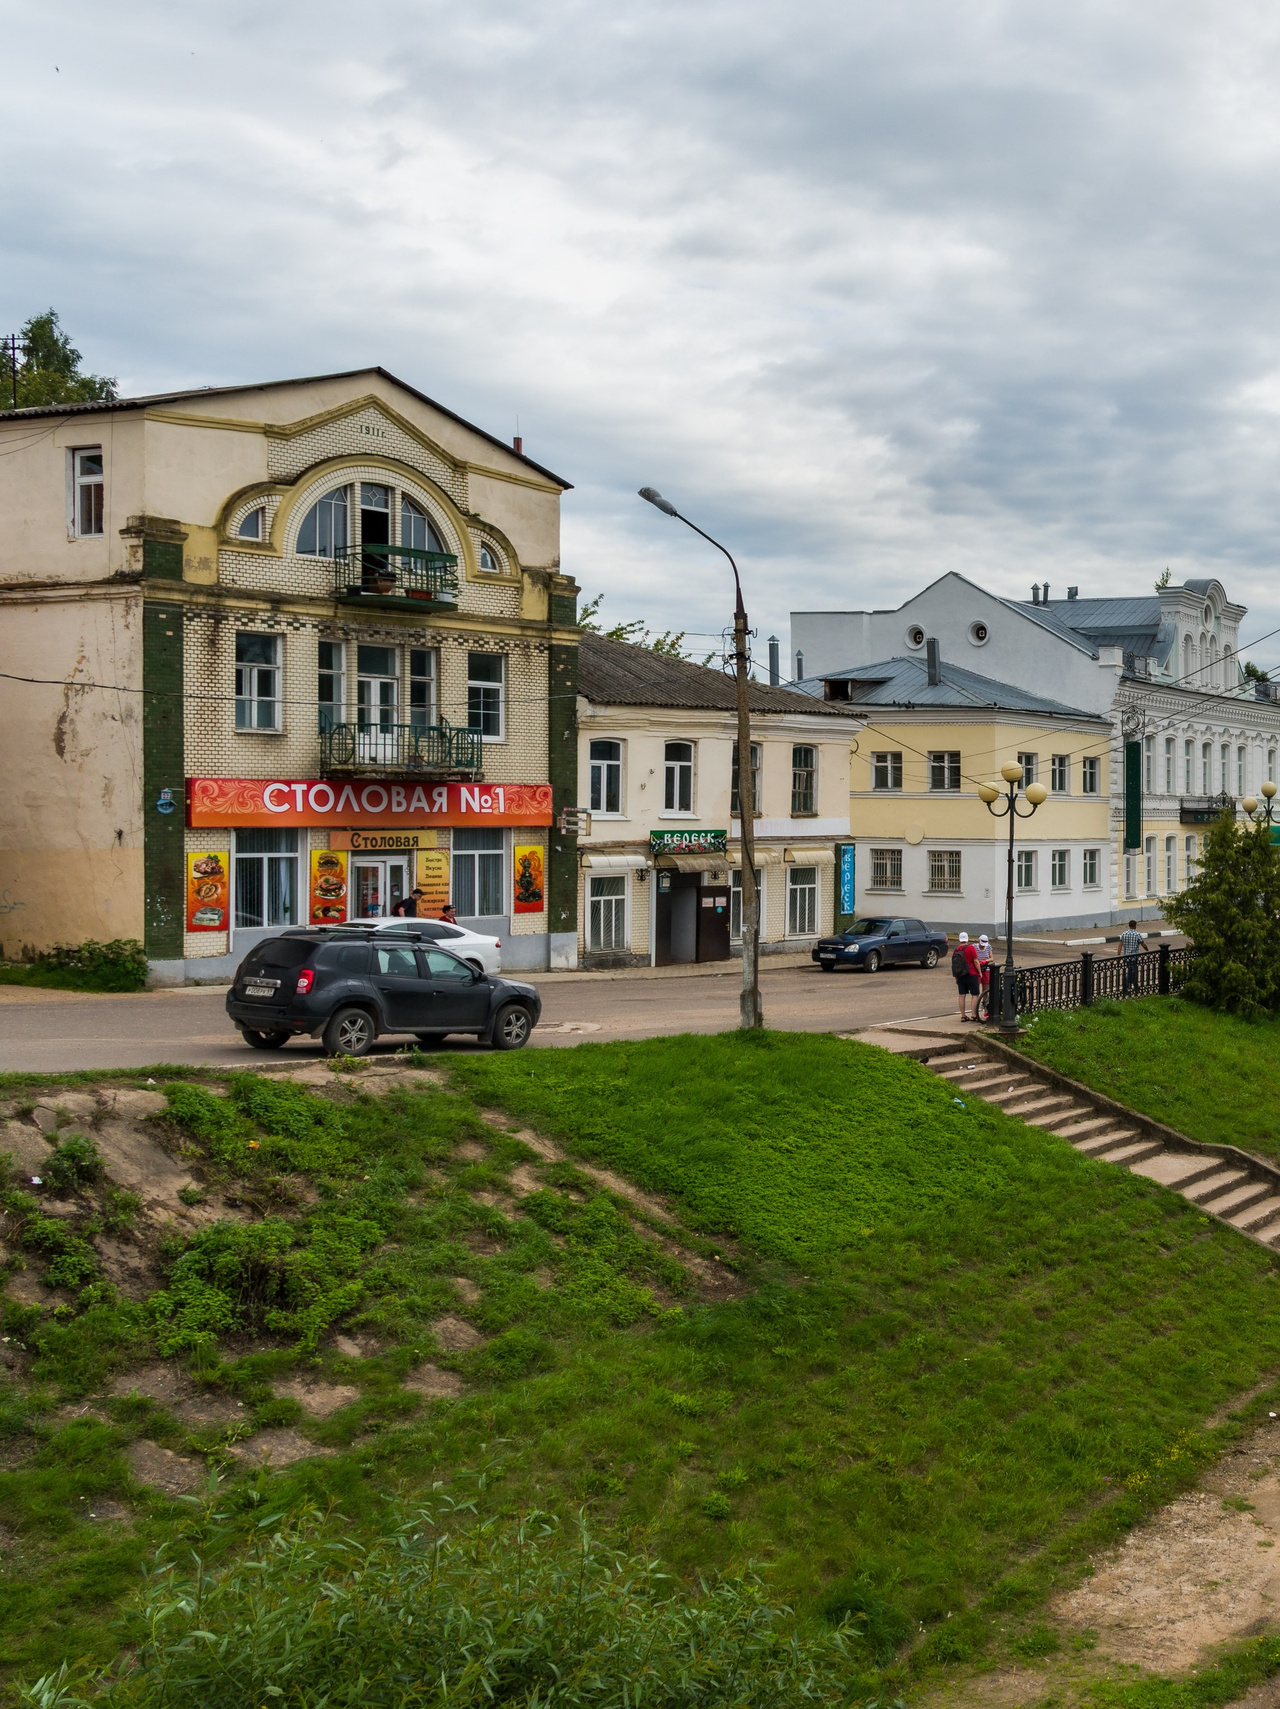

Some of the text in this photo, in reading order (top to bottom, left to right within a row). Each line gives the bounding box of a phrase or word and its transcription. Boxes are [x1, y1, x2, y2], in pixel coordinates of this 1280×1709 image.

[263, 783, 505, 813] СТОЛОВАЯ №1
[350, 832, 419, 848] Столовая
[664, 833, 715, 848] ВЕРЕСК
